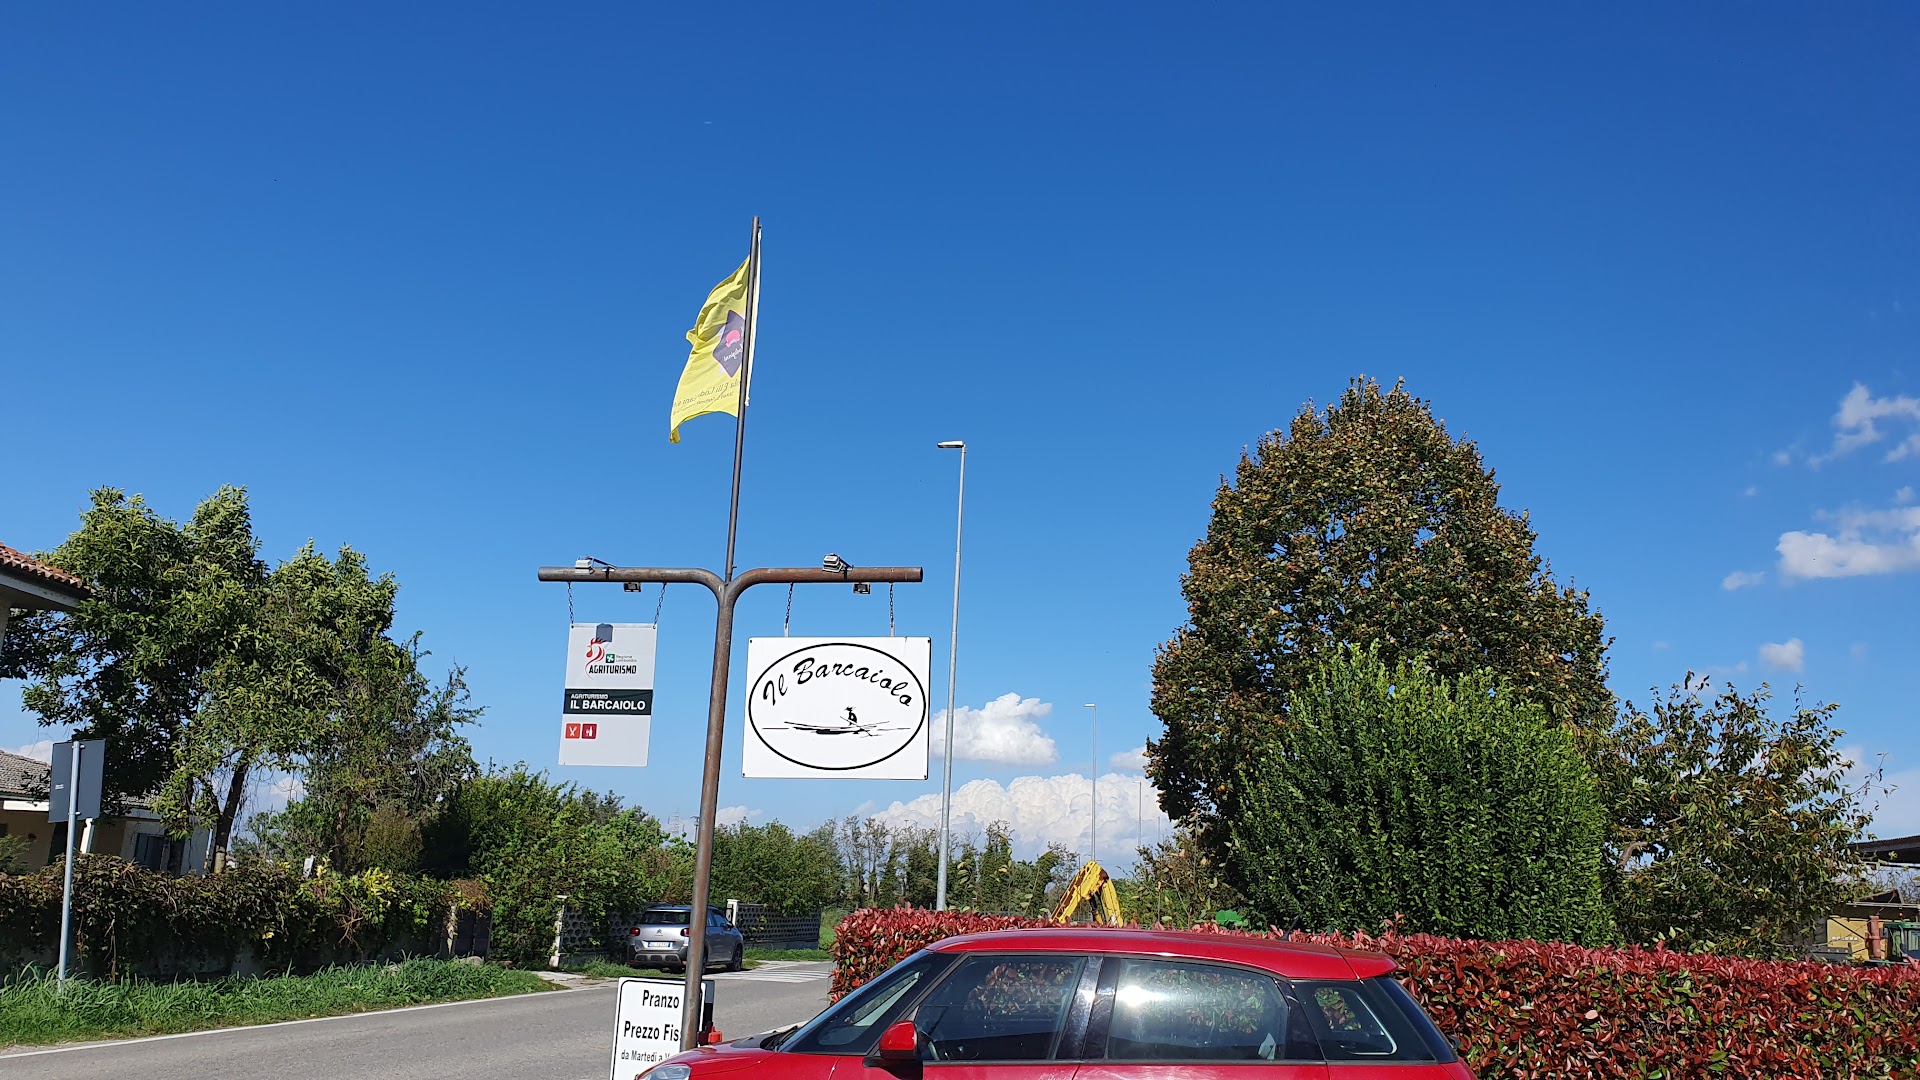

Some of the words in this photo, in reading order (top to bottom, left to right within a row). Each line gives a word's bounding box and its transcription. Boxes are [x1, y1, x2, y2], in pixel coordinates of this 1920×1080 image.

[588, 665, 637, 674] AGRITURISMO
[763, 673, 788, 706] Il
[793, 657, 912, 706] Barcaiolo
[570, 700, 580, 709] IL
[582, 700, 646, 710] BARCAIOLO
[642, 989, 680, 1009] Pranzo
[623, 1020, 660, 1040] Prezzo
[663, 1023, 681, 1042] Fis
[621, 1049, 629, 1060] da
